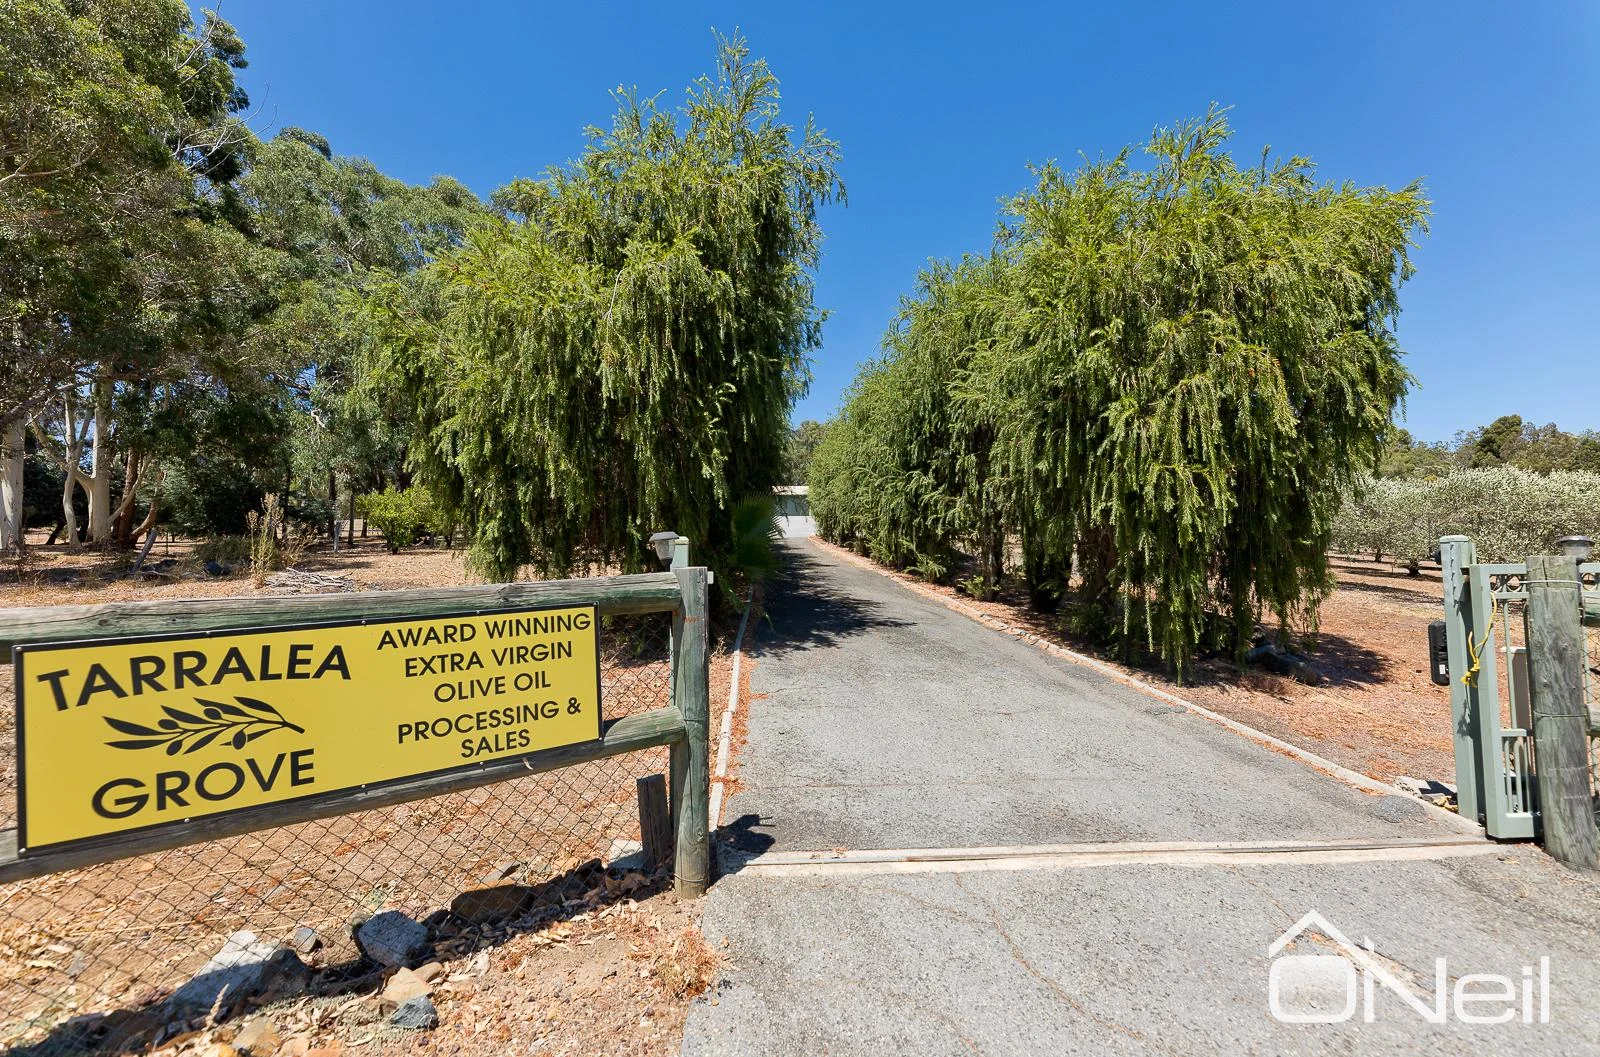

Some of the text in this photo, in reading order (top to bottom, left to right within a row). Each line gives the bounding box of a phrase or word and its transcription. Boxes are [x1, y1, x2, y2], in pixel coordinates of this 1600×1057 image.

[376, 612, 591, 651] AWARD WINNING
[36, 644, 352, 712] TARRALEA
[405, 640, 572, 678] EXTRA VIRGIN
[434, 670, 552, 703] OLIVE OIL
[398, 696, 582, 744] PROCESSING &
[461, 728, 531, 759] SALES
[91, 748, 315, 820] GROVE
